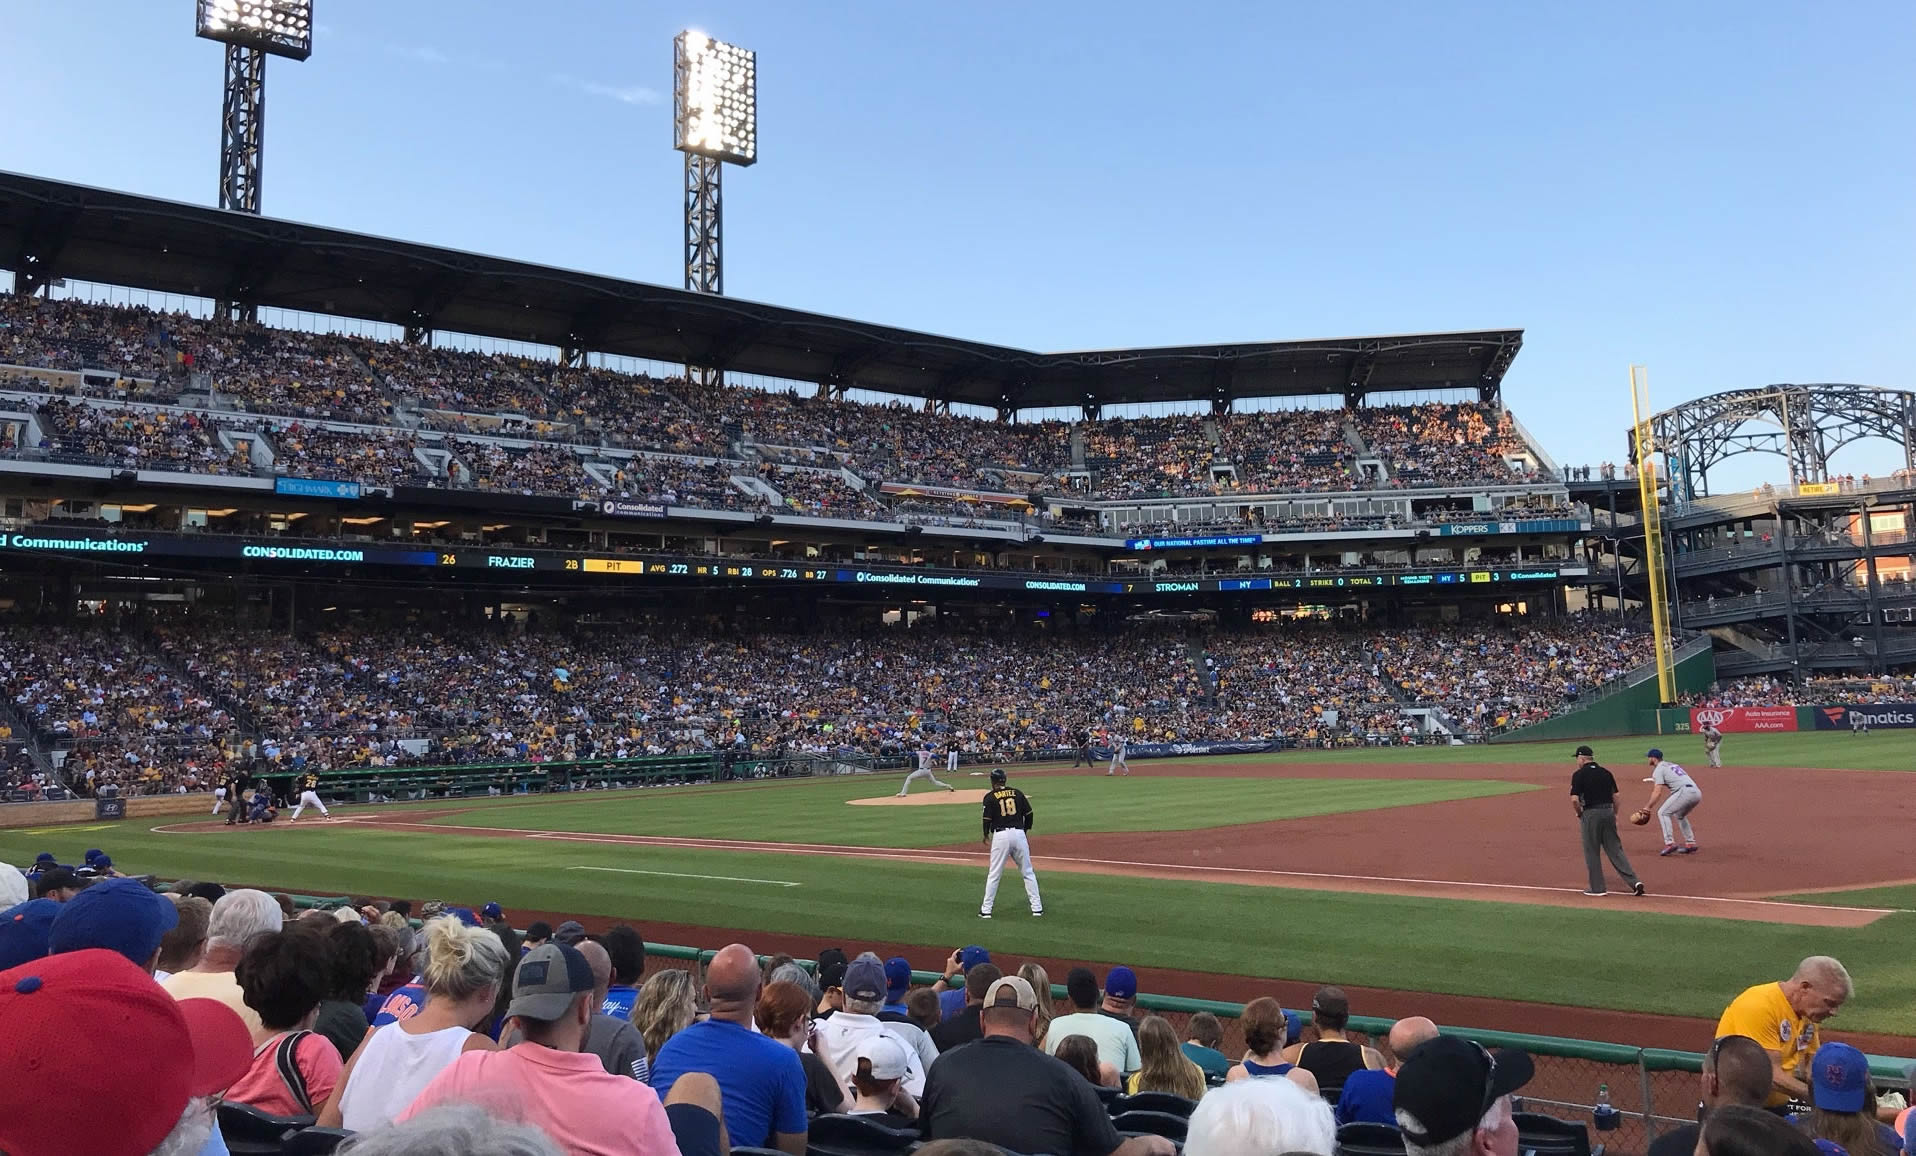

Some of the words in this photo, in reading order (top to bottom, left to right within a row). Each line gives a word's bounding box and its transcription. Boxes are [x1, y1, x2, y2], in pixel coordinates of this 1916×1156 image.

[617, 502, 664, 513] Consolidated
[1451, 524, 1489, 535] KOPPERS
[12, 535, 144, 552] Communications
[243, 546, 364, 562] CONSOLIDATED.COM
[442, 554, 456, 565] 26
[488, 555, 535, 569] FRAZIER
[565, 559, 579, 570] 2B
[606, 562, 622, 571] PIT
[650, 565, 666, 573] AVG
[669, 565, 688, 574] .272
[697, 567, 707, 575] HR
[712, 566, 719, 575] 5
[727, 567, 739, 575] RBI
[741, 567, 752, 577] 28
[762, 569, 776, 577] OPS
[780, 569, 798, 578] .726
[805, 571, 814, 579] BB
[816, 570, 827, 579] 27
[1459, 573, 1466, 582] 5
[1493, 572, 1500, 581] 3
[866, 573, 916, 584] Consolidated
[917, 575, 979, 587] Communications
[1026, 580, 1086, 592] CONSOLIDATED.COM
[1274, 580, 1291, 588] BALL
[1295, 579, 1301, 588] 2
[1337, 578, 1344, 586] 0
[1376, 577, 1382, 585] 2
[1127, 584, 1134, 592] 7
[1155, 583, 1199, 592] STROMAN
[1239, 581, 1251, 589] NY
[1699, 711, 1721, 721] AAA
[999, 798, 1017, 817] 18
